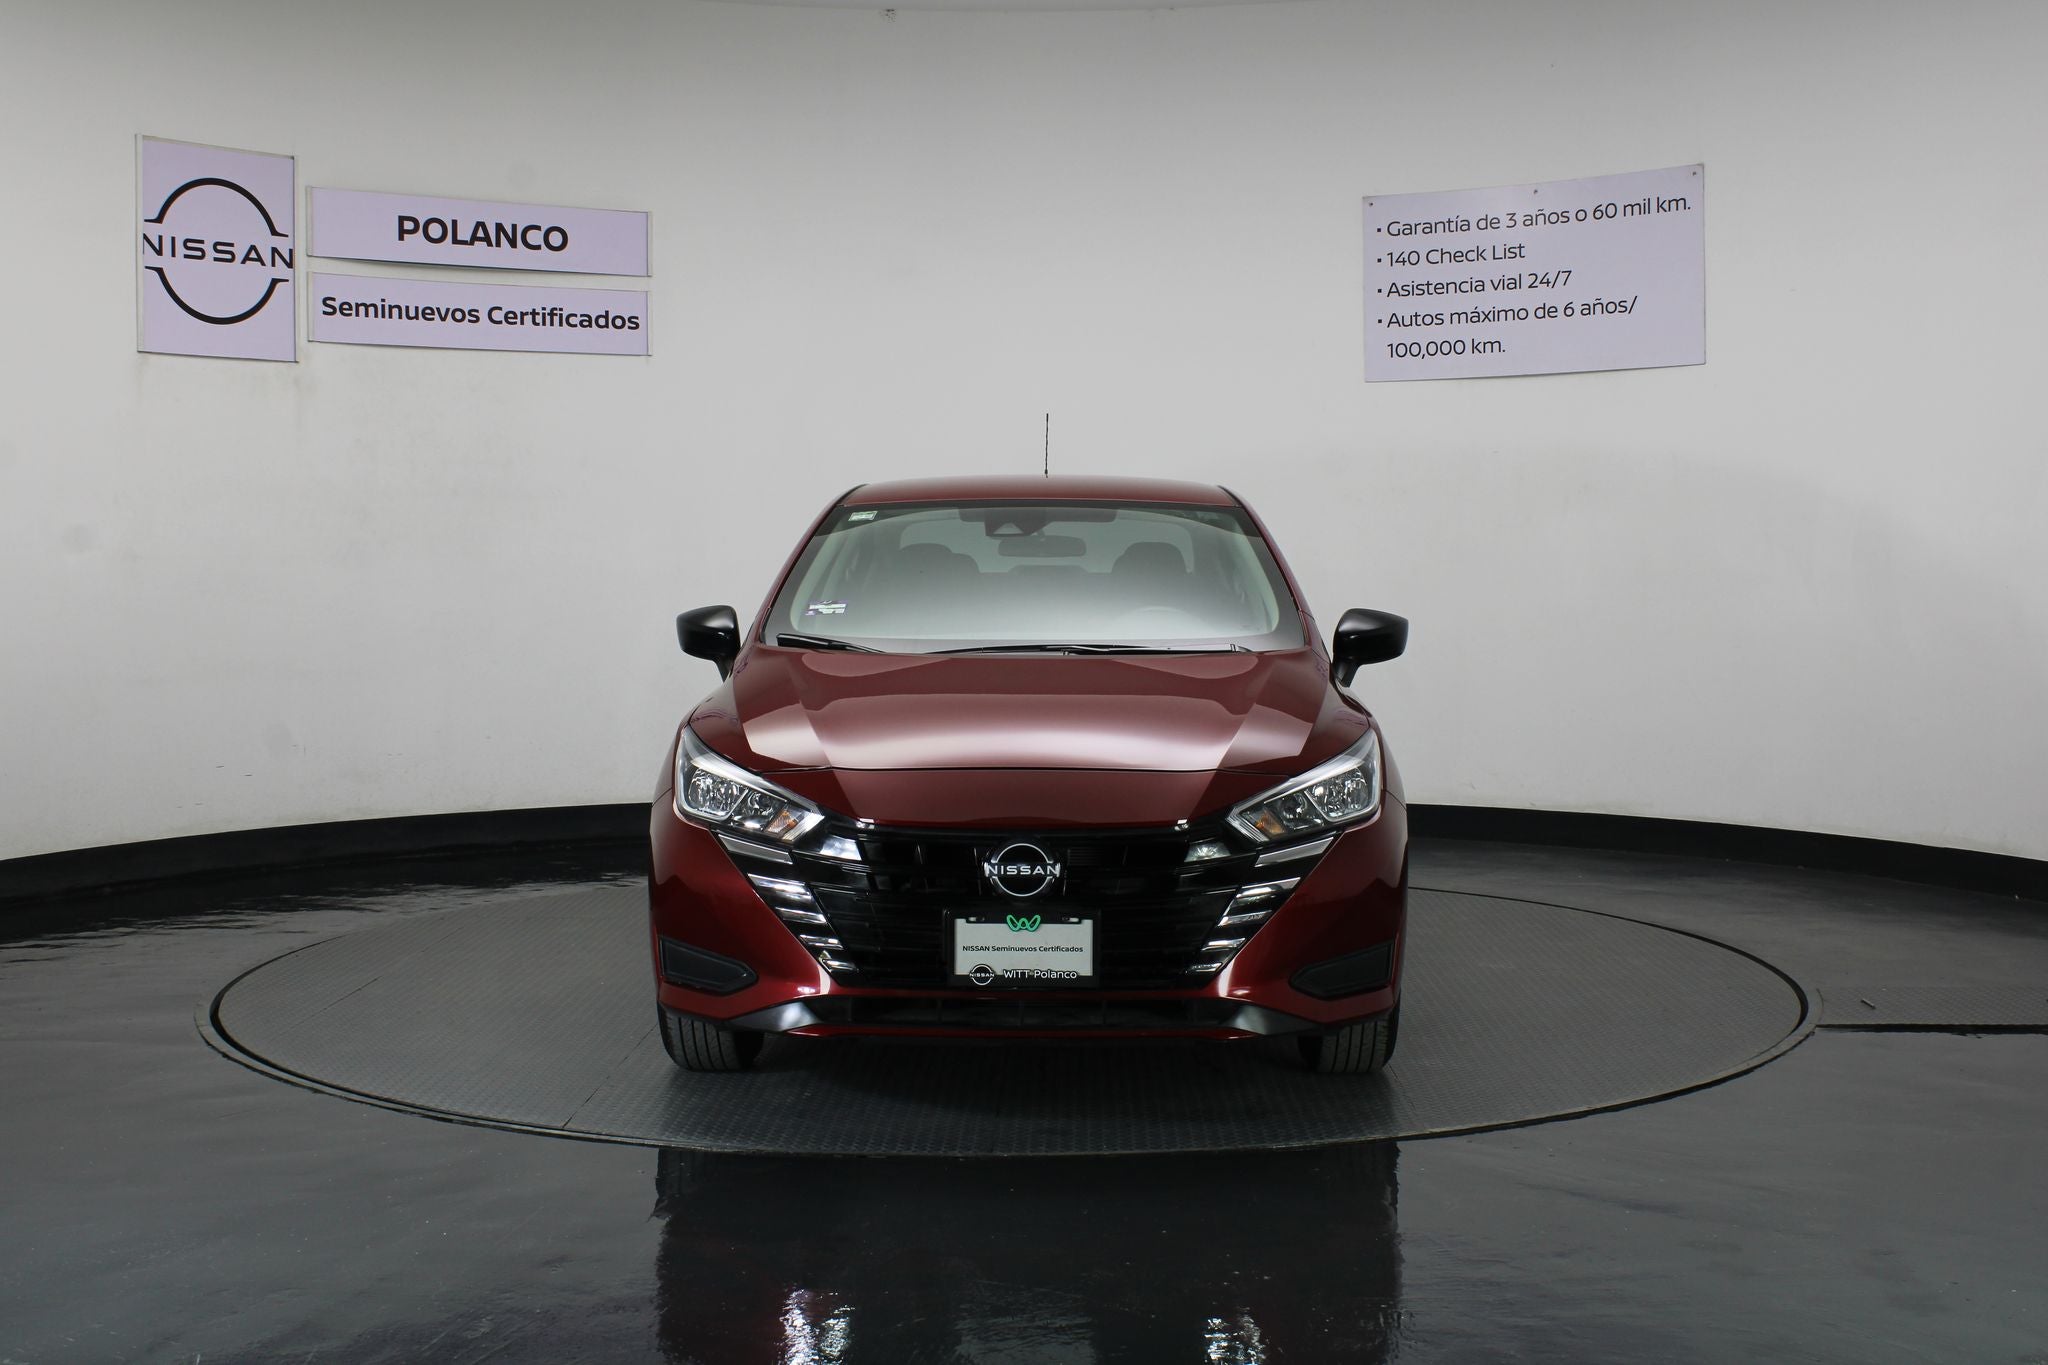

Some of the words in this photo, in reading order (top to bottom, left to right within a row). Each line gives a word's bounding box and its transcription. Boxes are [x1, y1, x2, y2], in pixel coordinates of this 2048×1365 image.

[1386, 213, 1471, 237] Garantía
[1476, 211, 1501, 231] de
[1505, 212, 1517, 229] 3
[1522, 207, 1570, 228] años
[1575, 208, 1588, 222] o
[1592, 201, 1618, 221] 60
[1623, 198, 1651, 218] mil
[1656, 195, 1692, 214] km.
[397, 214, 569, 252] POLANCO
[143, 232, 294, 270] NISSAN
[1386, 250, 1421, 268] 140
[1425, 245, 1487, 265] Check
[1492, 243, 1526, 261] List
[1386, 276, 1486, 298] Asistencia
[1490, 272, 1522, 292] vial
[1527, 269, 1573, 289] 24/7
[321, 296, 481, 325] Seminuevos
[487, 305, 641, 331] Certificados
[1386, 311, 1445, 329] Autos
[1449, 304, 1529, 326] máximo
[1533, 302, 1559, 321] de
[1563, 301, 1575, 318] 6
[1580, 295, 1638, 317] años/
[1386, 340, 1466, 360] 100,000
[1471, 337, 1507, 355] km.
[985, 865, 1059, 876] NISSAN
[962, 945, 990, 953] NISSAN
[991, 944, 1037, 953] Seminuevos
[1038, 944, 1084, 953] Certificados
[1003, 969, 1029, 979] WITT
[1034, 969, 1078, 979] Polanco
